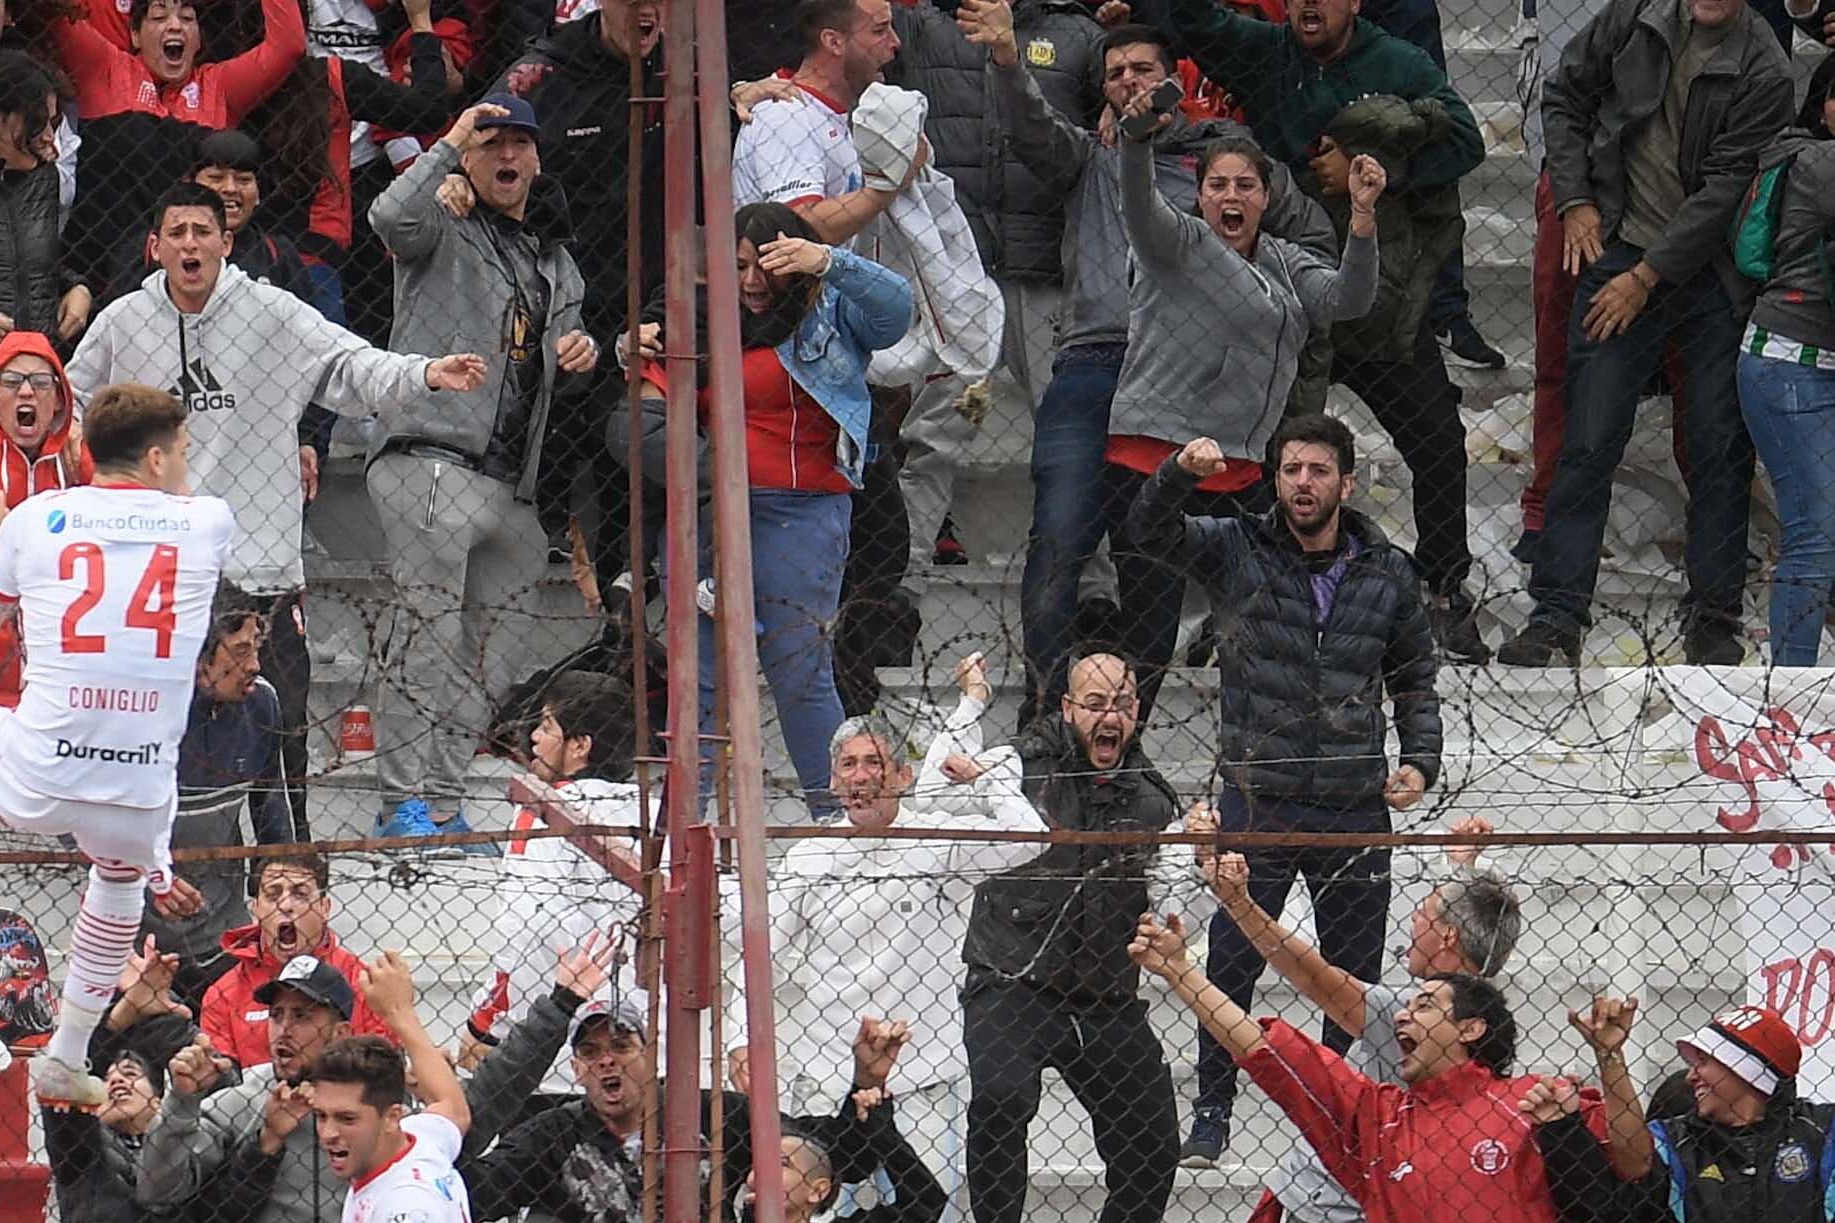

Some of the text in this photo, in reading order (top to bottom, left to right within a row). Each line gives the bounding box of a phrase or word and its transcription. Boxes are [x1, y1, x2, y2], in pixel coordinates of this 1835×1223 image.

[188, 392, 236, 413] idas
[59, 541, 179, 659] 24
[68, 685, 160, 713] CONIGLIO
